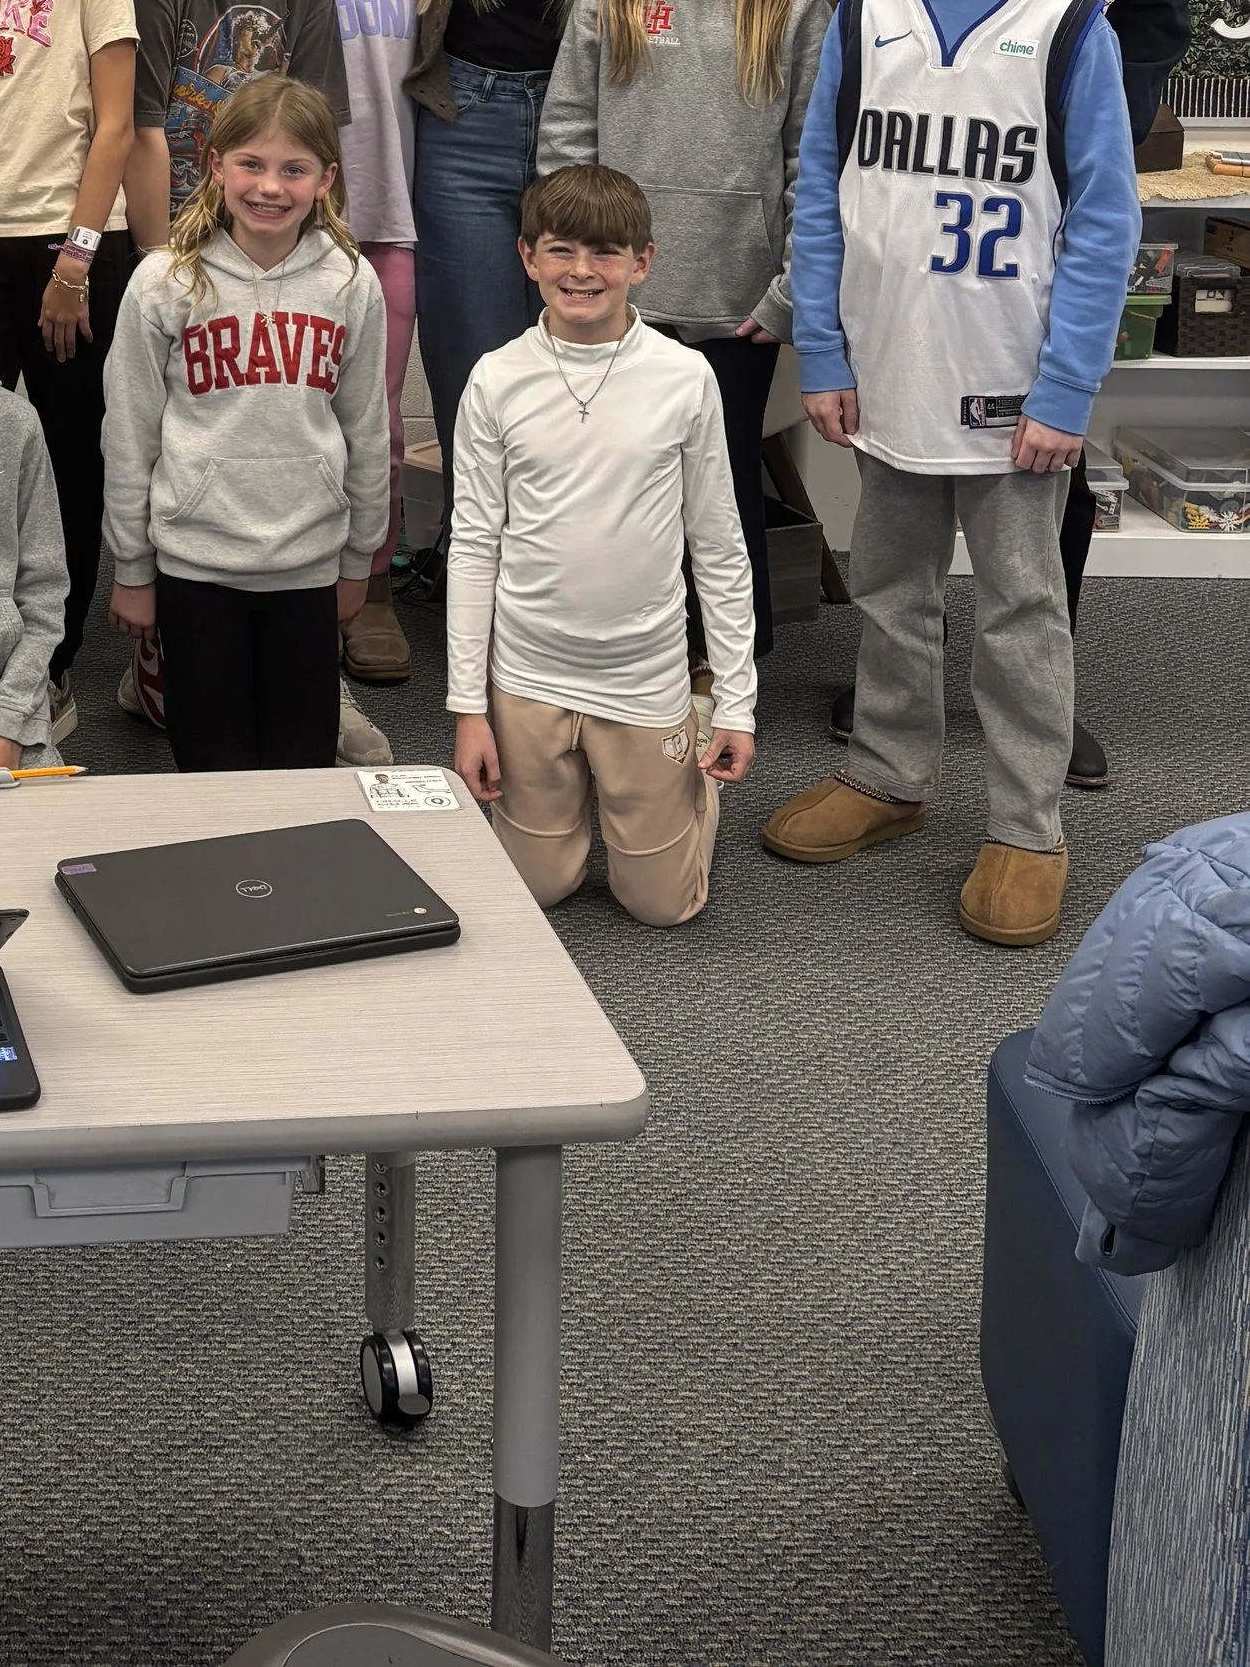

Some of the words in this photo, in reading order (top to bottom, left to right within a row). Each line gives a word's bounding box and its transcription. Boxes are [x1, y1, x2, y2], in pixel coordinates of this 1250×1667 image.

[999, 38, 1035, 56] chime
[857, 109, 1040, 186] DALLAS
[930, 191, 1025, 280] 32
[182, 311, 347, 397] BRAVES
